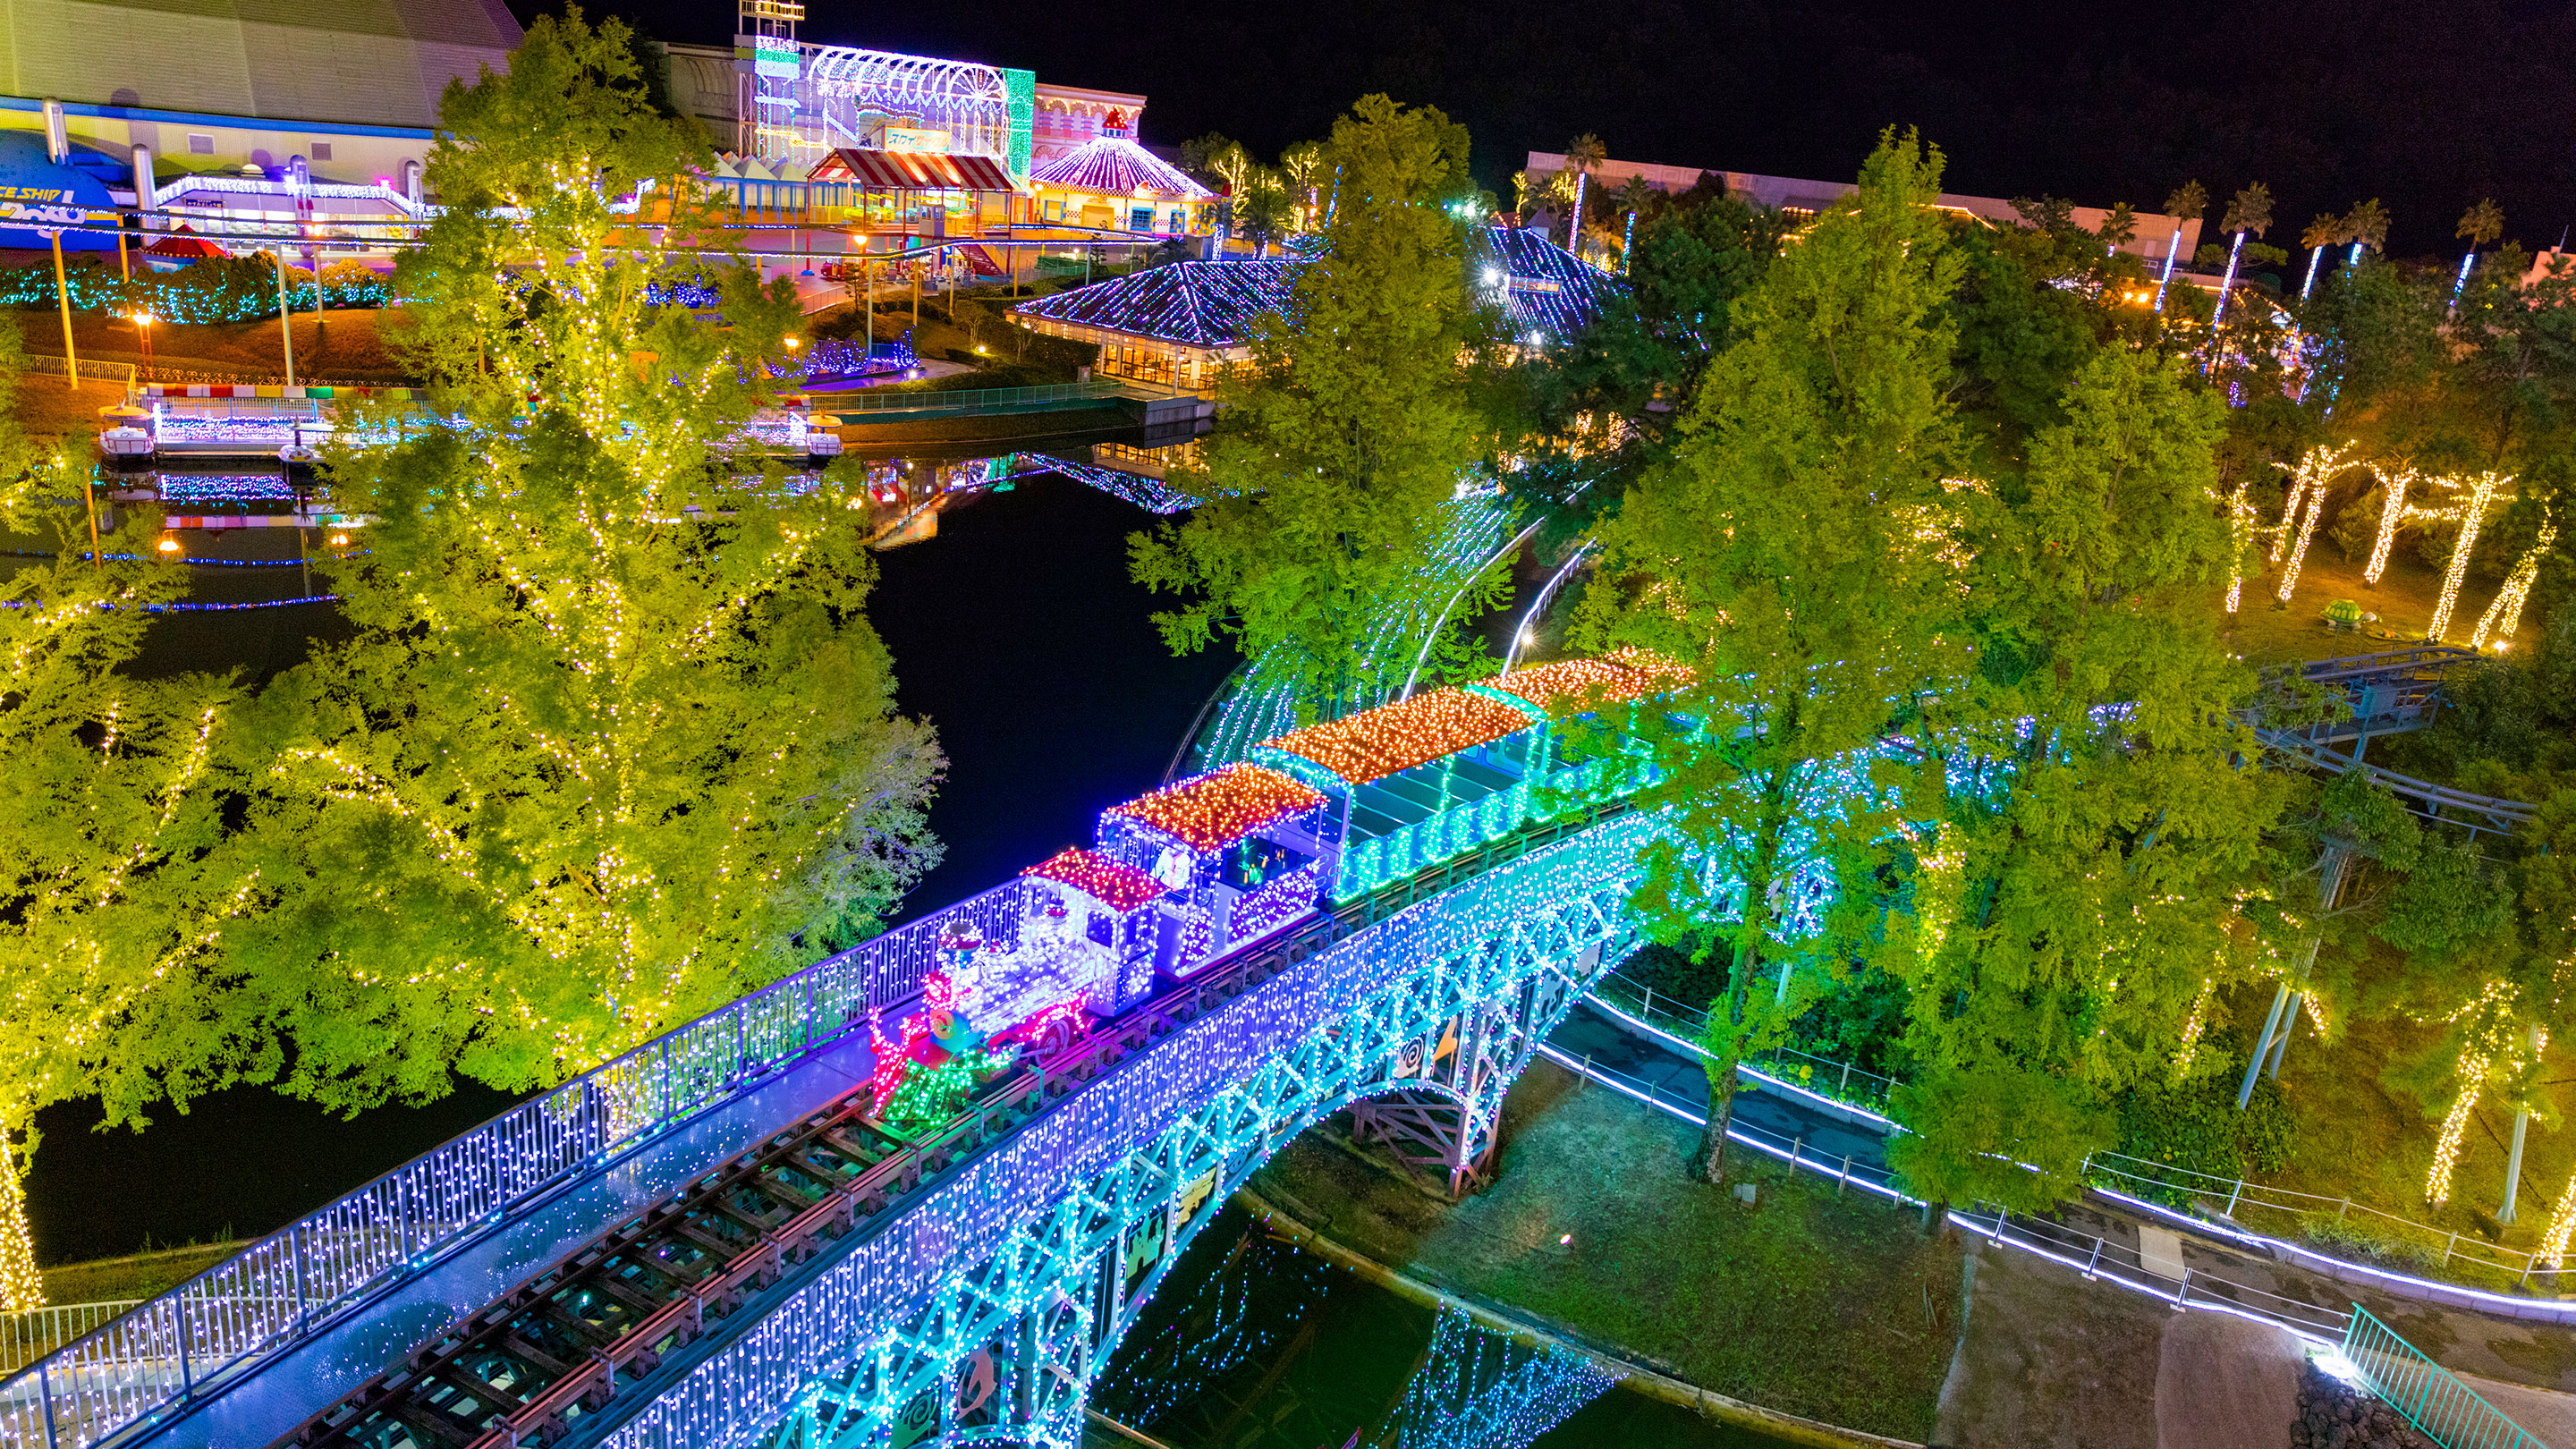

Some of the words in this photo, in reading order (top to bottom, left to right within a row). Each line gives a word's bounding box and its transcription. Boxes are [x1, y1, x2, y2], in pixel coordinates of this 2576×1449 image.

[888, 133, 948, 148] スカイサイクル
[17, 188, 62, 202] SHIP
